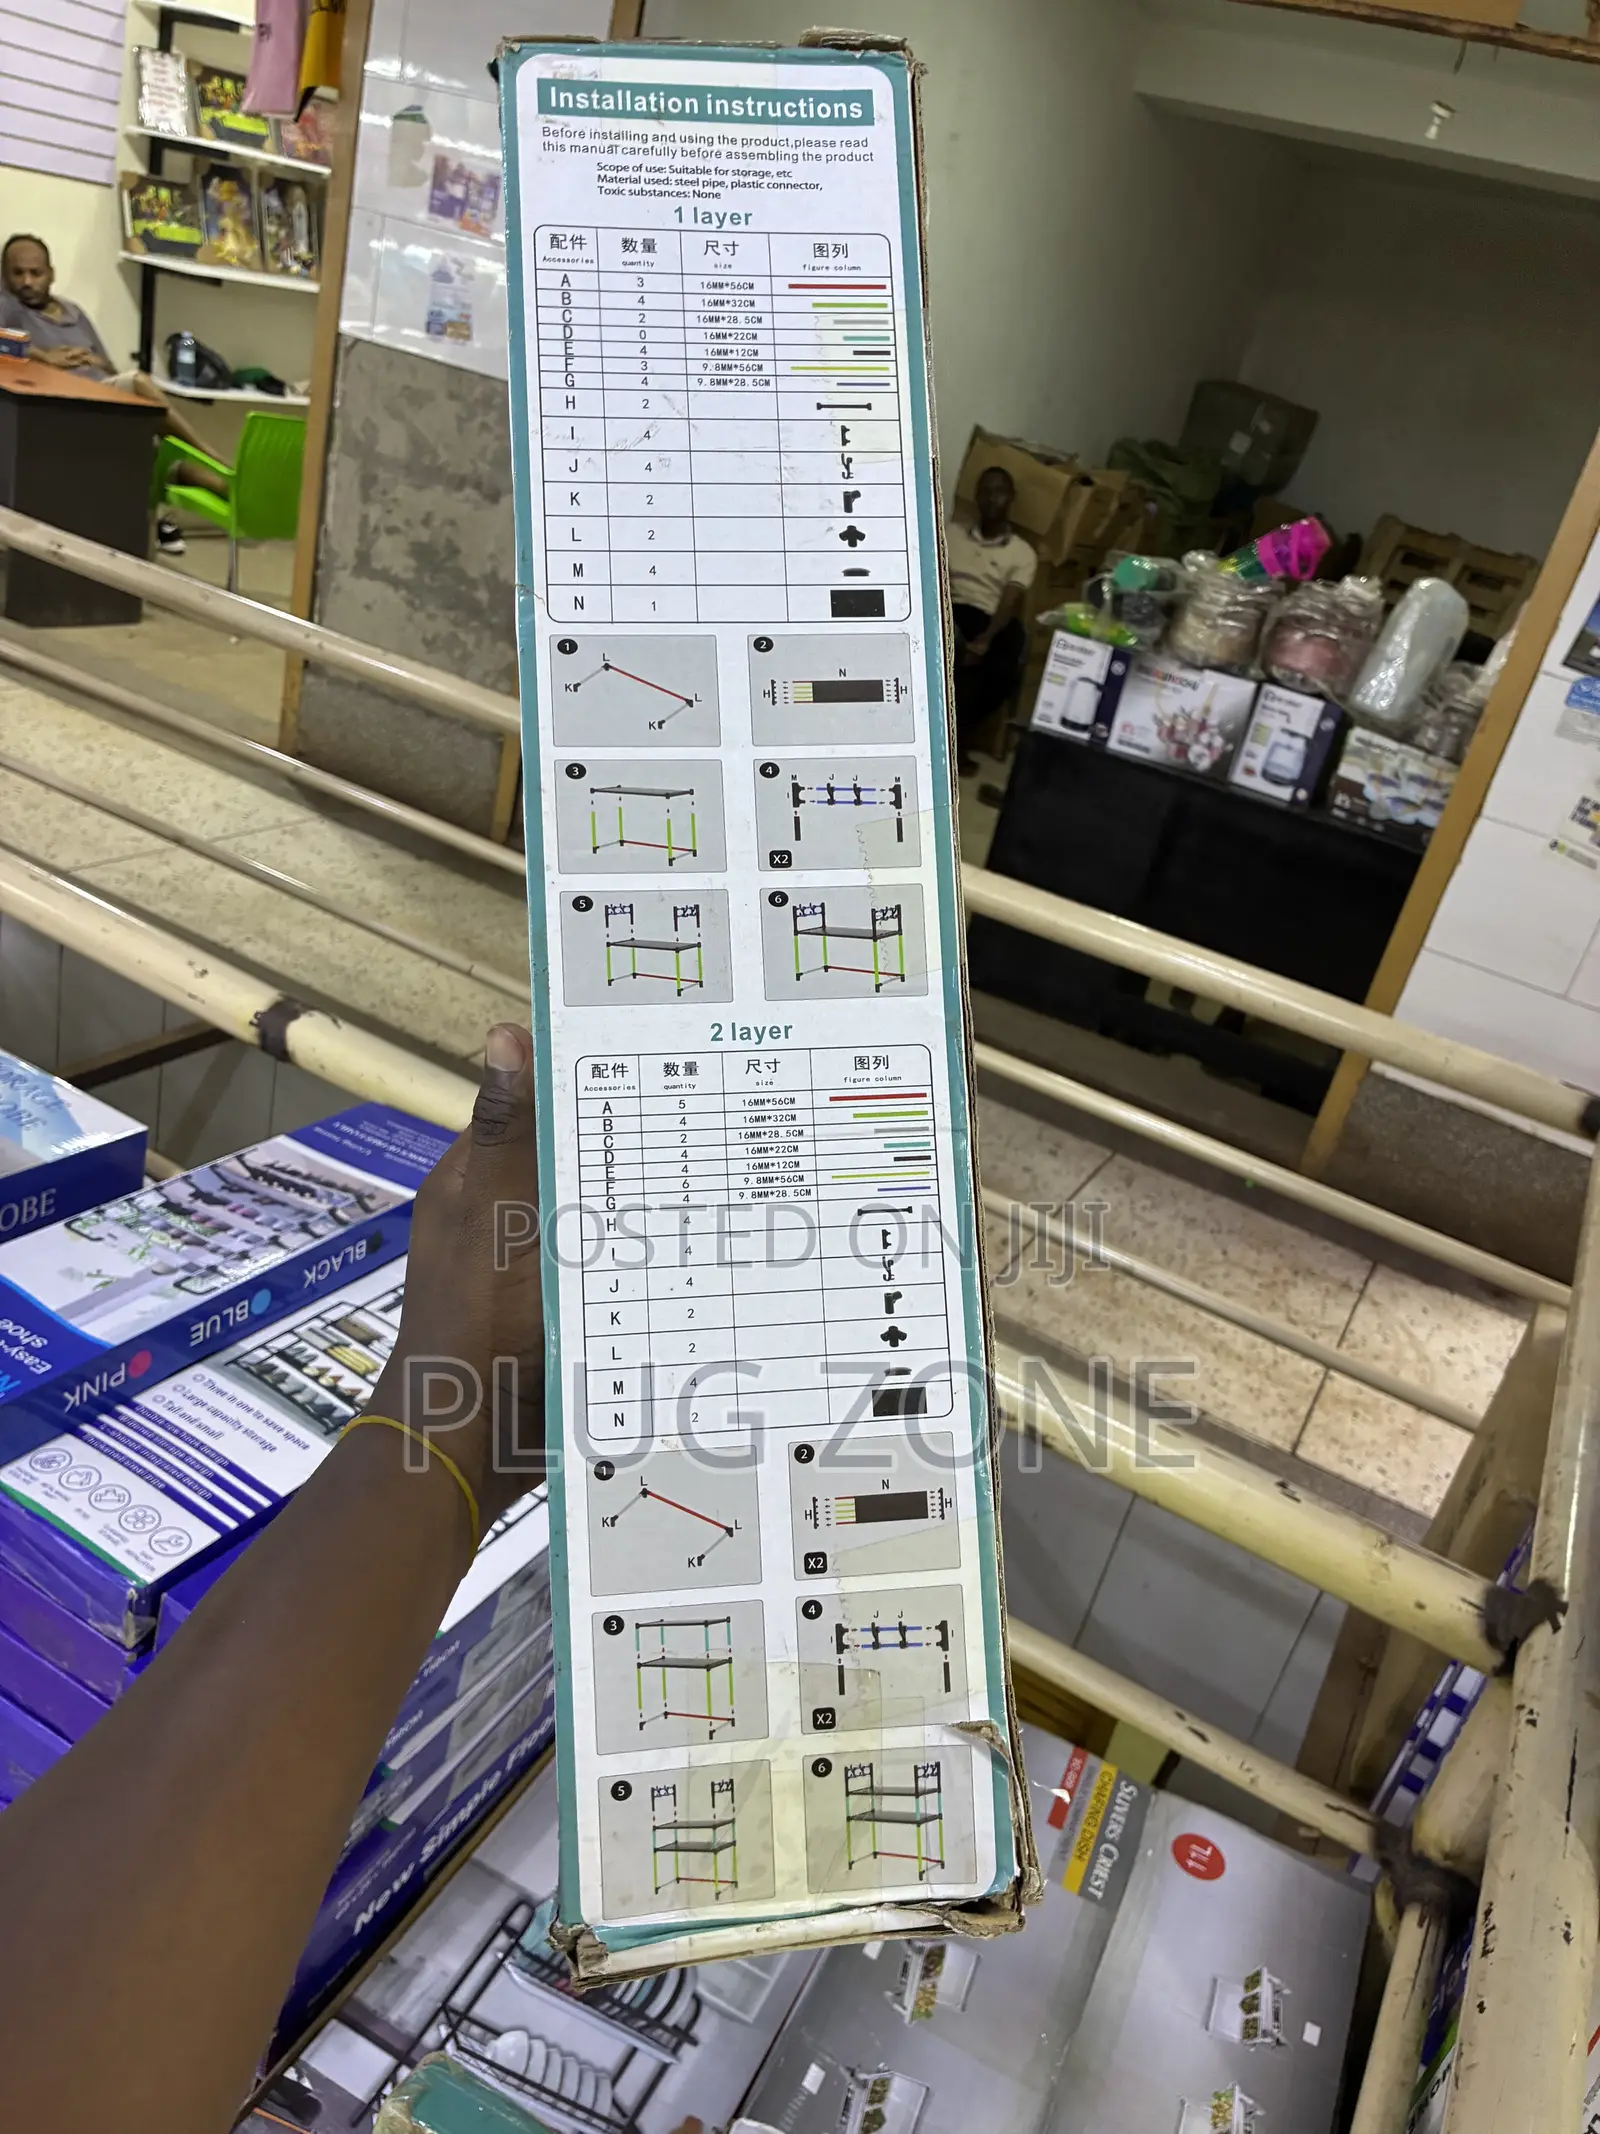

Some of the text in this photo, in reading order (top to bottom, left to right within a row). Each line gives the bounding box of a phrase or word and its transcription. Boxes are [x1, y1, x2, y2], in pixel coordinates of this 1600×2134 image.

[550, 86, 863, 119] Installation instructions
[542, 126, 586, 139] Before
[589, 128, 648, 144] installing
[652, 132, 676, 143] and
[679, 133, 714, 147] using
[717, 134, 737, 146] the
[840, 137, 868, 148] read
[542, 141, 566, 152] this
[621, 145, 677, 159] carefully
[681, 147, 722, 159] before
[725, 149, 799, 163] assembling
[802, 151, 822, 162] the
[825, 151, 874, 164] product
[596, 162, 793, 179] Scope of use: Suitable for storage, etc
[597, 174, 823, 191] Material used: steel pipe, plastic connector,
[597, 185, 722, 199] Toxic substances: None
[674, 206, 753, 229] 1 layer
[549, 233, 587, 251] 配件
[621, 237, 658, 254] 数量
[703, 240, 740, 257] 尺寸
[813, 242, 849, 259] 图列
[621, 260, 655, 268] quantity
[802, 263, 861, 271] figure column
[560, 273, 572, 288] A
[637, 277, 645, 288] 3
[561, 291, 572, 306] B
[637, 295, 646, 306] 4
[562, 309, 573, 323] C
[638, 313, 646, 324] 2
[563, 325, 573, 339] D
[639, 345, 648, 356] 4
[640, 361, 648, 371] 3
[564, 373, 575, 388] G
[640, 376, 649, 386] 4
[565, 395, 650, 410] H 2
[643, 430, 651, 440] 4
[568, 459, 653, 473] J 4
[570, 491, 653, 506] K 2
[571, 527, 655, 542] L 2
[573, 563, 657, 577] M 4
[574, 596, 585, 610] N
[773, 854, 789, 864] X2
[710, 1022, 793, 1045] 2 layer
[591, 1062, 629, 1079] 配件
[663, 1061, 699, 1077] 数量
[745, 1058, 781, 1075] 尺寸
[854, 1055, 889, 1071] 图列
[584, 1083, 636, 1092] Accessories
[663, 1082, 696, 1090] quantity
[844, 1076, 870, 1084] figure
[602, 1101, 613, 1115] A
[678, 1099, 686, 1109] 5
[603, 1118, 613, 1132] B
[679, 1116, 687, 1126] 4
[603, 1135, 614, 1149] C
[680, 1134, 687, 1144] 2
[604, 1150, 615, 1164] D
[680, 1150, 689, 1160] 4
[681, 1164, 689, 1174] 4
[682, 1179, 690, 1189] 6
[606, 1196, 616, 1210] G
[682, 1194, 690, 1204] 4
[607, 1215, 691, 1232] H 4
[684, 1245, 693, 1255] 4
[304, 1238, 367, 1289] BLACK
[609, 1276, 694, 1293] J 4
[190, 1298, 250, 1348] BLUE
[611, 1308, 695, 1325] K 2
[612, 1343, 696, 1361] L 2
[63, 1361, 126, 1414] PINK
[613, 1377, 698, 1395] M 4
[614, 1413, 699, 1427] N 2
[807, 1557, 824, 1569] X2
[816, 1712, 833, 1725] X2
[353, 1861, 416, 1937] New
[420, 1769, 502, 1864] Simple
